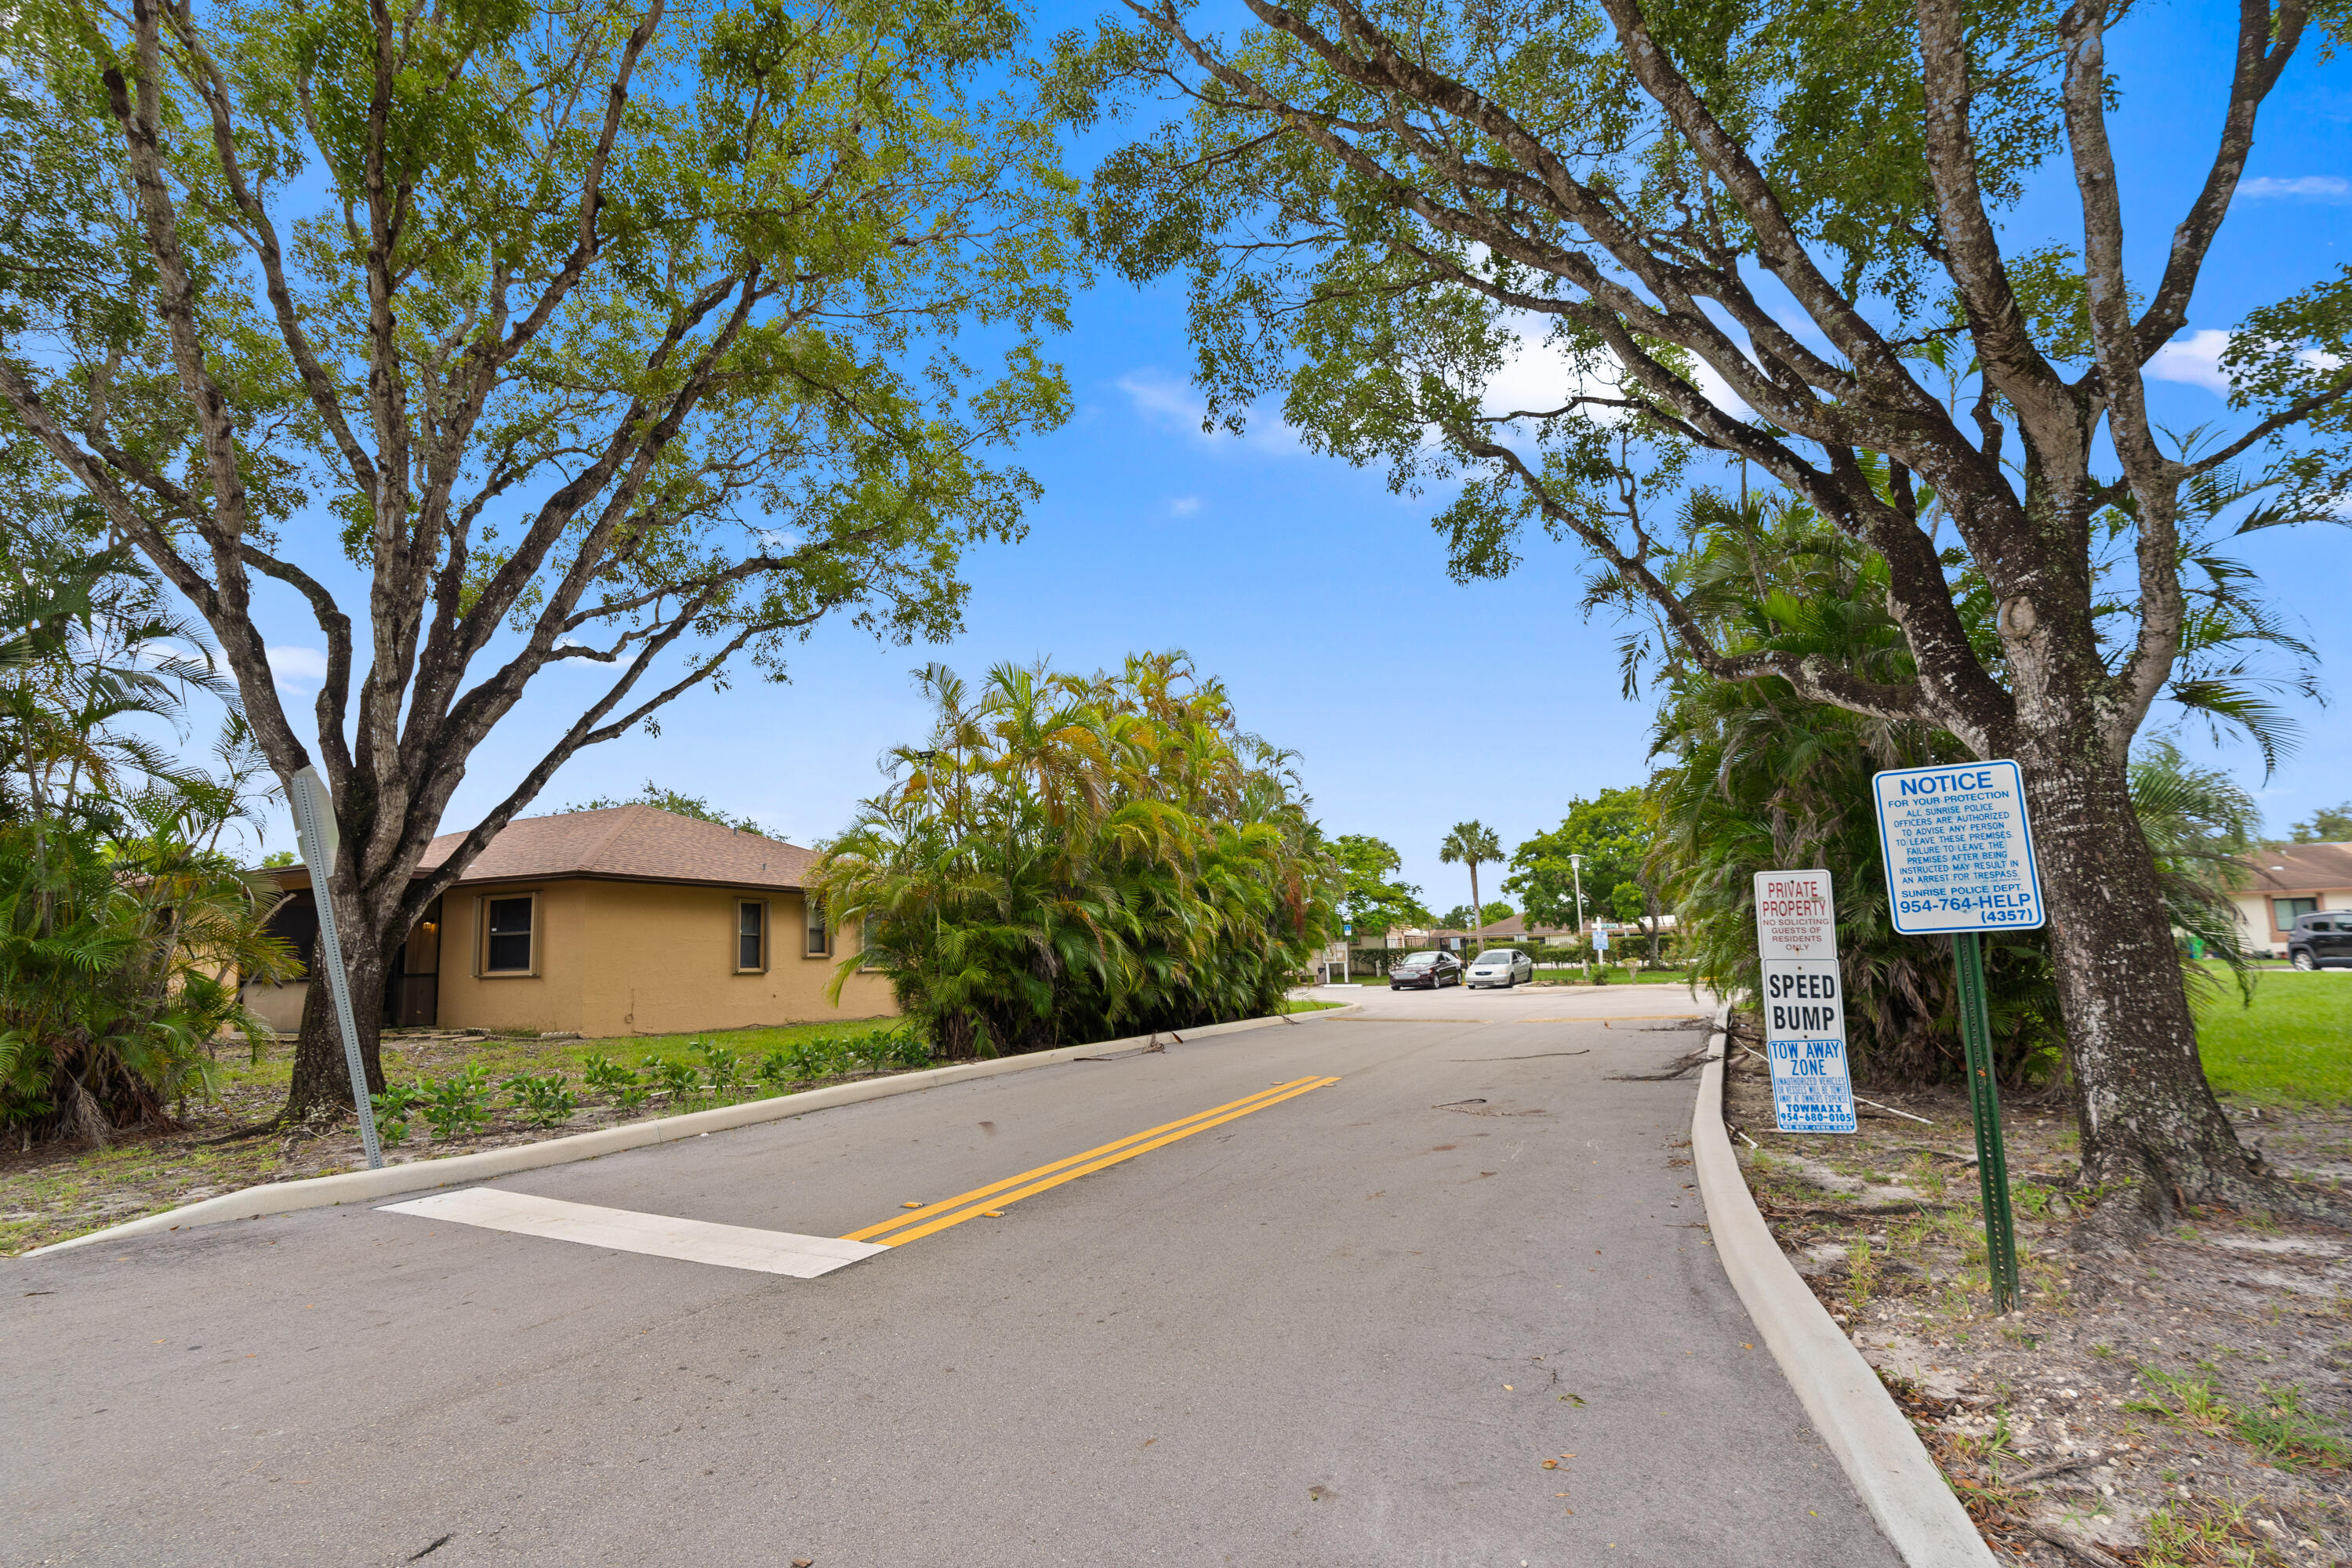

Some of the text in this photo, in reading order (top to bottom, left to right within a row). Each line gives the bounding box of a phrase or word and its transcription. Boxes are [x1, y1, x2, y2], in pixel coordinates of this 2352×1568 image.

[1900, 771, 1993, 795] NOTICE
[1913, 797, 1940, 806] YOUR
[1944, 790, 2009, 803] PROTECTION
[1907, 803, 1994, 817] ALL SUNRISE POLICE
[1894, 818, 1933, 828] OFFICERS
[1957, 811, 2009, 822] AUTHORIZED
[1916, 826, 1944, 836] ADVISE
[1970, 822, 2005, 831] PERSON
[1940, 835, 1965, 844] THESE
[1969, 831, 2013, 841] PREMISES.
[1907, 846, 1940, 855] FAILURE
[1958, 843, 1984, 851] LEAVE
[1907, 851, 2007, 865] PREMISES AFTER BEING
[1900, 865, 1949, 875] INSTRUCTED
[1974, 861, 2007, 869] RESULT
[1918, 874, 1949, 883] ARREST
[1768, 881, 1818, 898] PRIVATE
[1901, 884, 2024, 898] SUNRISE POLICE DEPT.
[1762, 900, 1825, 916] PROPERTY
[1900, 893, 2031, 913] 954-764-HELP
[1981, 908, 2033, 924] (4357)
[1769, 974, 1835, 999] SPEED
[1773, 1006, 1835, 1030] BUMP
[1772, 1042, 1839, 1059] TOW AWAY
[1791, 1059, 1827, 1076] ZONE
[1776, 1076, 1846, 1085] UNAUTHORIZED VEHICLES
[1825, 1094, 1848, 1103] EXPENSE
[1786, 1104, 1842, 1112] TOWMAXX
[1780, 1112, 1852, 1122] 954-680-0105
